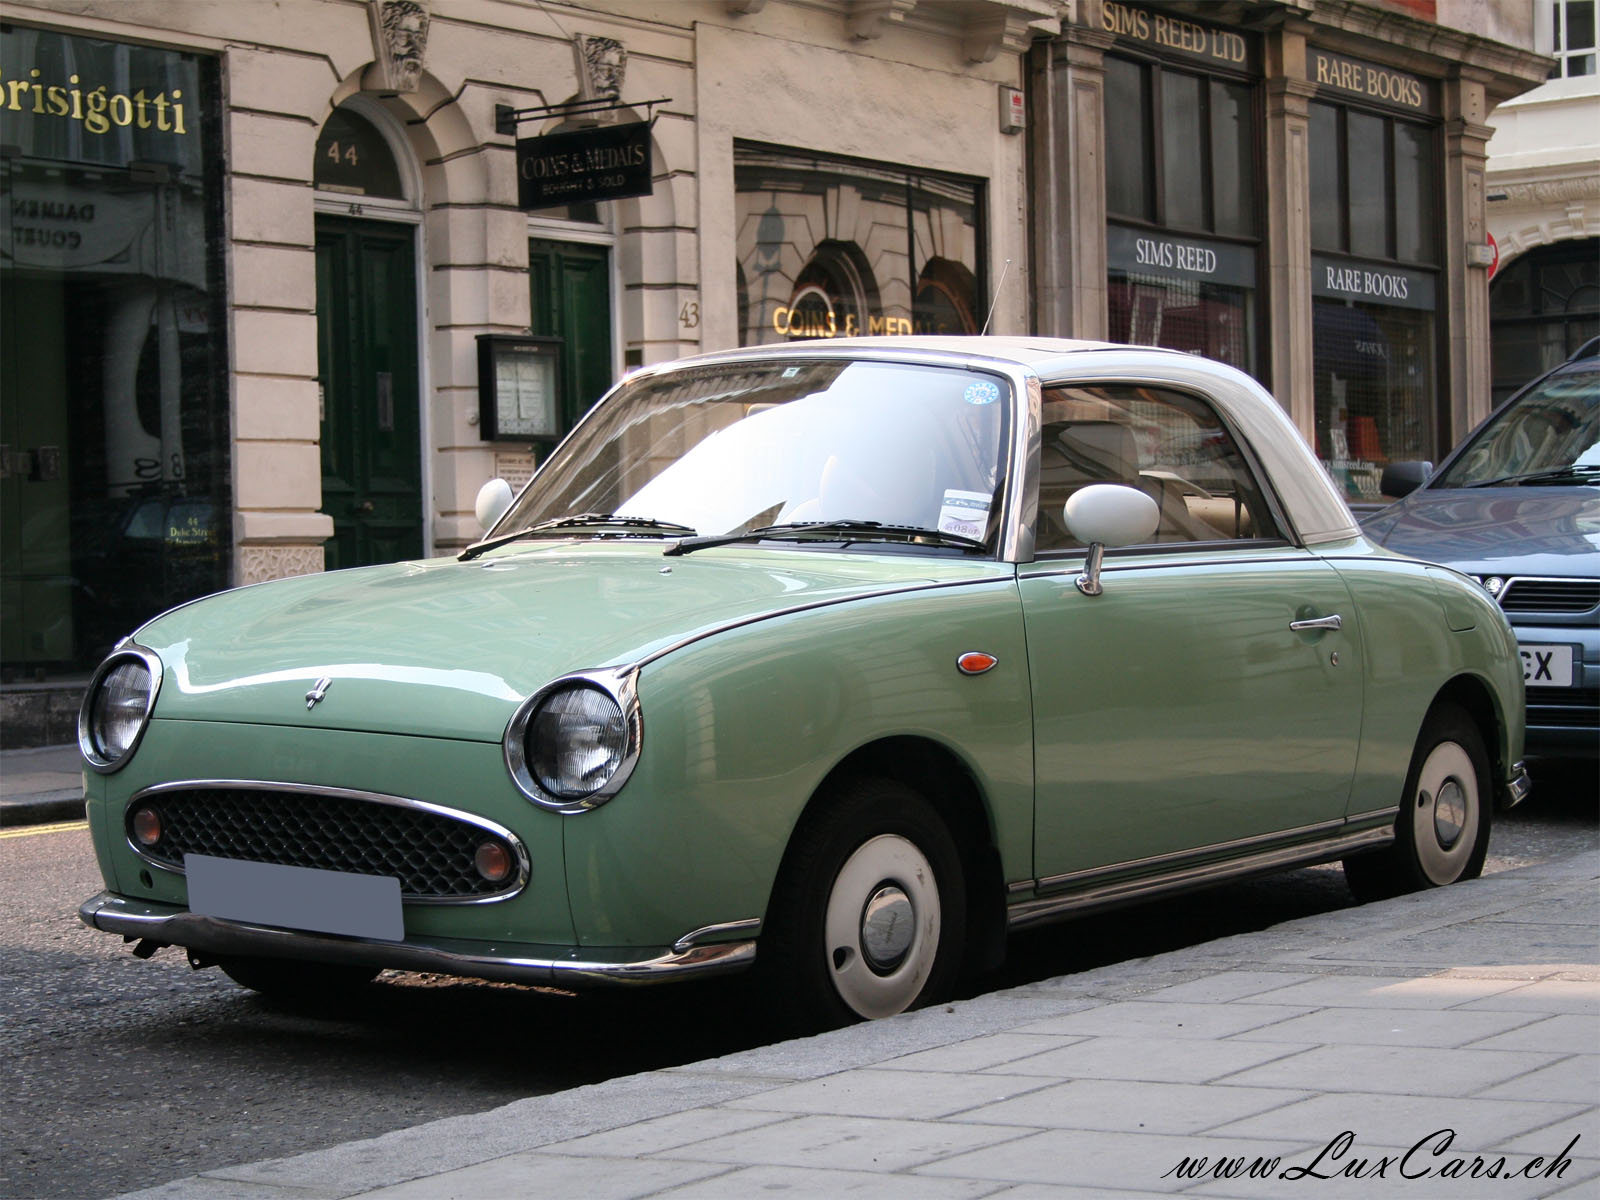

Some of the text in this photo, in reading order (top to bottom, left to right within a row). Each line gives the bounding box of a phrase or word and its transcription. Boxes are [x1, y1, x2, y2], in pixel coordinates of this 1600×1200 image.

[1103, 2, 1245, 62] SIMS REED LTD
[1317, 55, 1421, 107] RARE BOOKS
[328, 141, 358, 166] 44
[521, 144, 645, 180] COINS & MEDALS
[600, 174, 625, 188] SOLD
[348, 203, 363, 216] 44
[1136, 238, 1216, 273] SIMS REED
[1326, 266, 1408, 300] RARE BOOKS
[679, 301, 699, 329] 43
[772, 307, 836, 338] COINS
[845, 314, 860, 337] &
